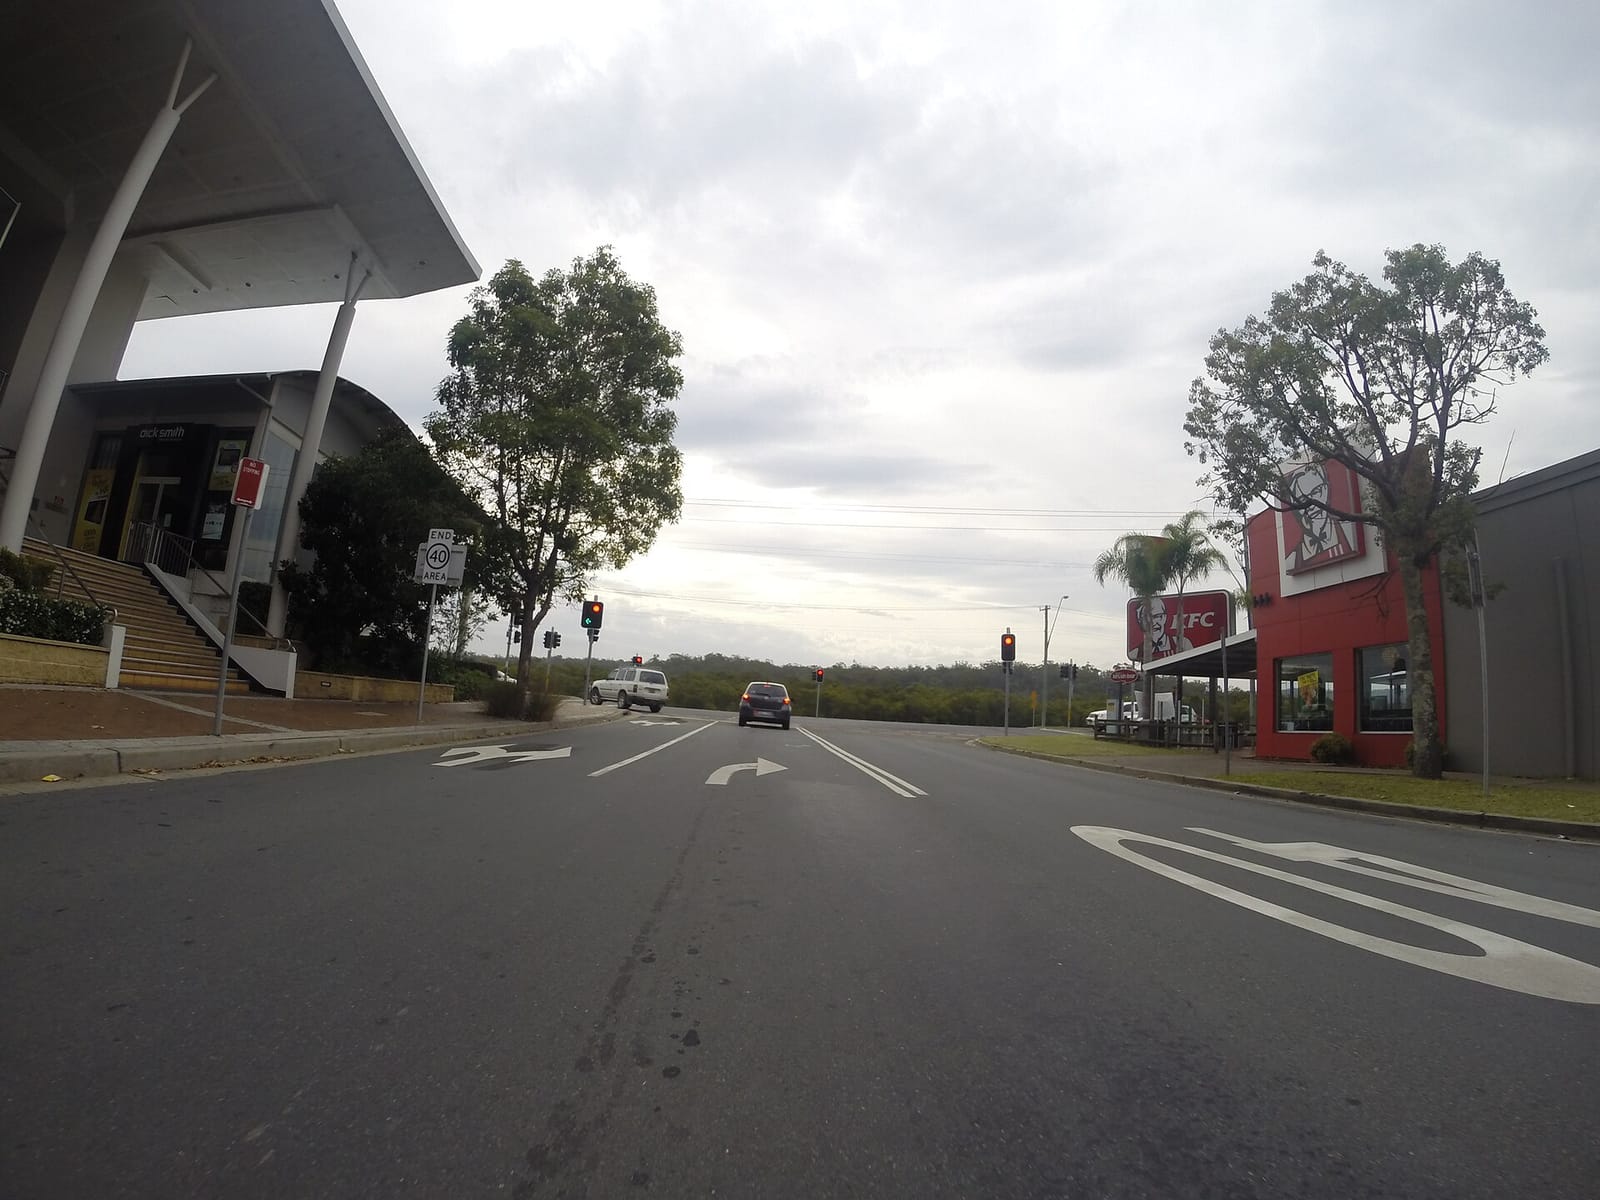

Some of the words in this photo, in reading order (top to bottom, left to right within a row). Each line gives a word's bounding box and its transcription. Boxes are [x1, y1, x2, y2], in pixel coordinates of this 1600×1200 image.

[159, 425, 185, 438] smith
[430, 531, 451, 540] END
[429, 550, 447, 563] 40
[423, 571, 446, 581] AREA
